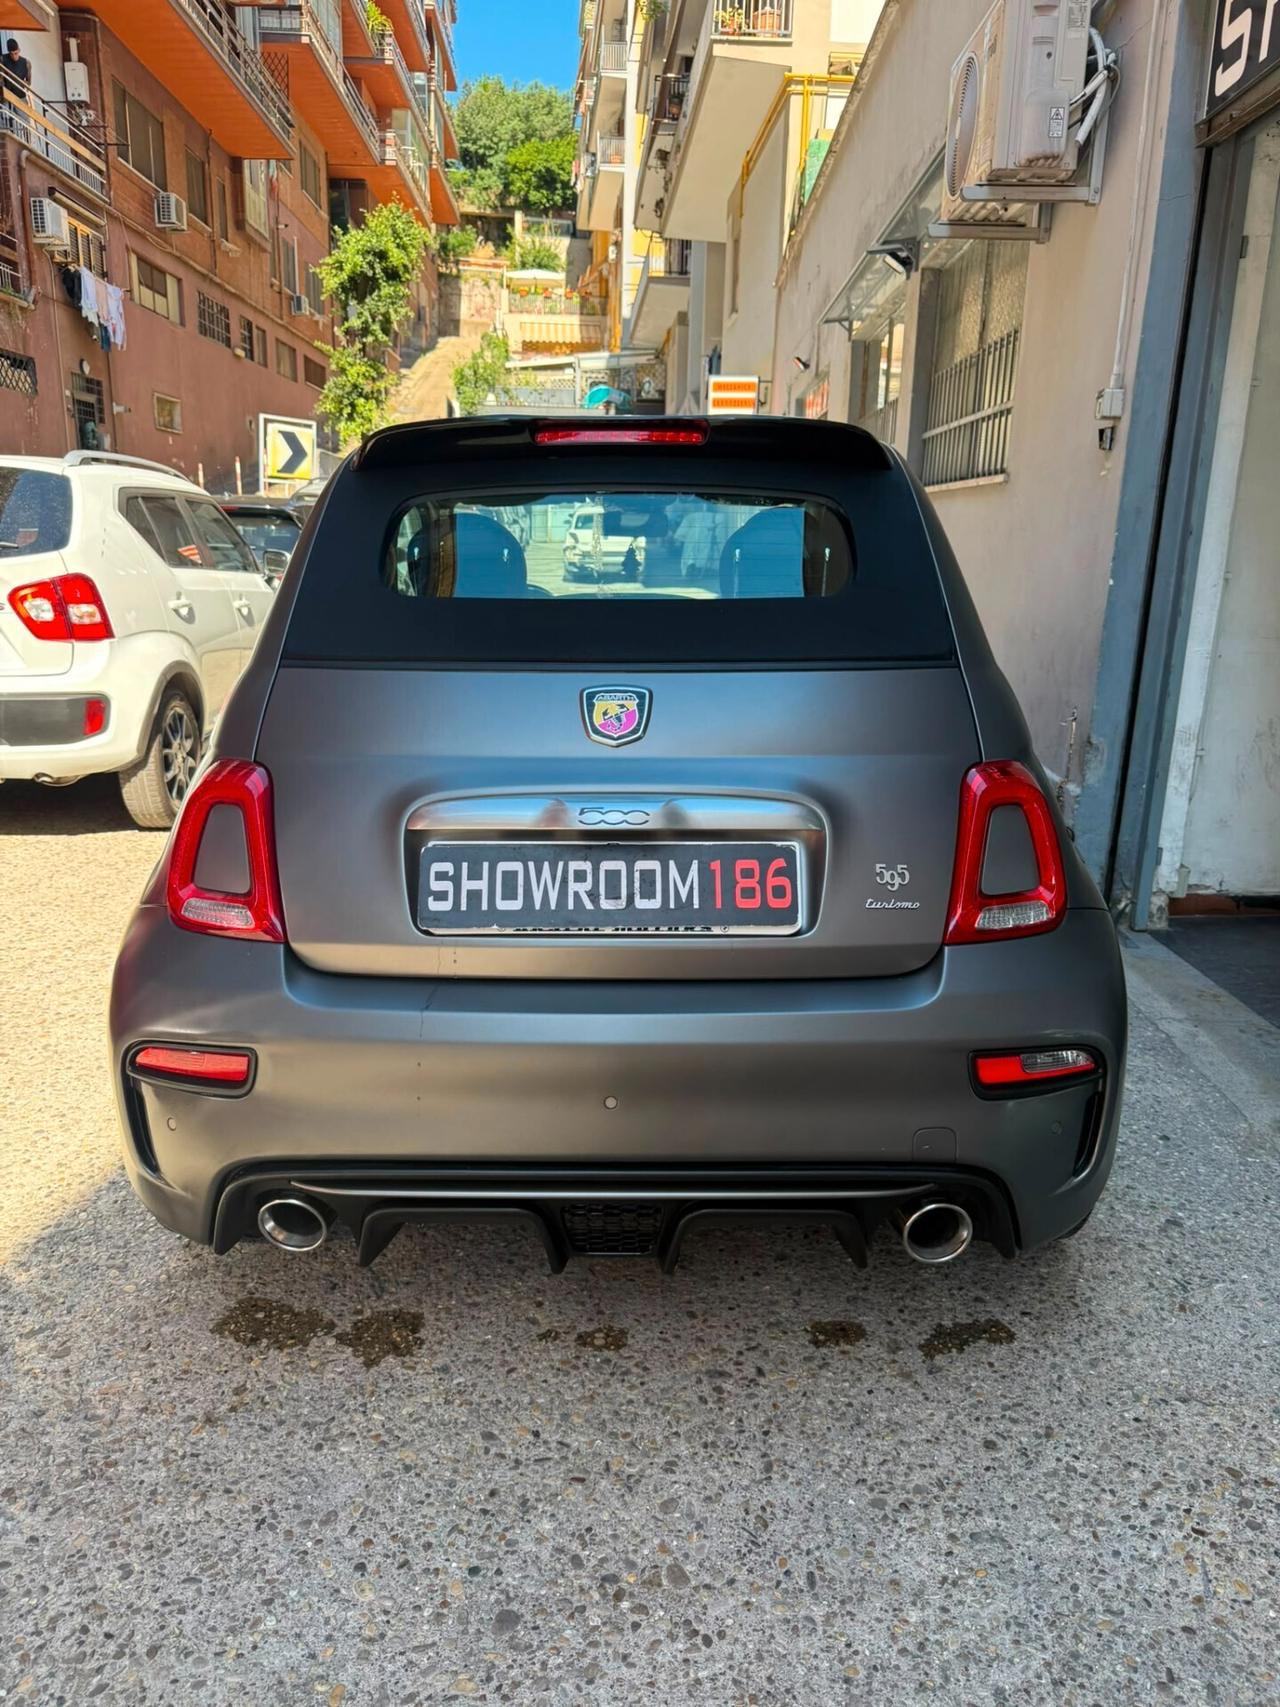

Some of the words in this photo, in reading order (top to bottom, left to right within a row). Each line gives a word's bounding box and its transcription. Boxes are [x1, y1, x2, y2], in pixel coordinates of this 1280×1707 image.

[578, 807, 650, 826] 500
[875, 863, 910, 891] 595
[865, 898, 920, 909] turismo
